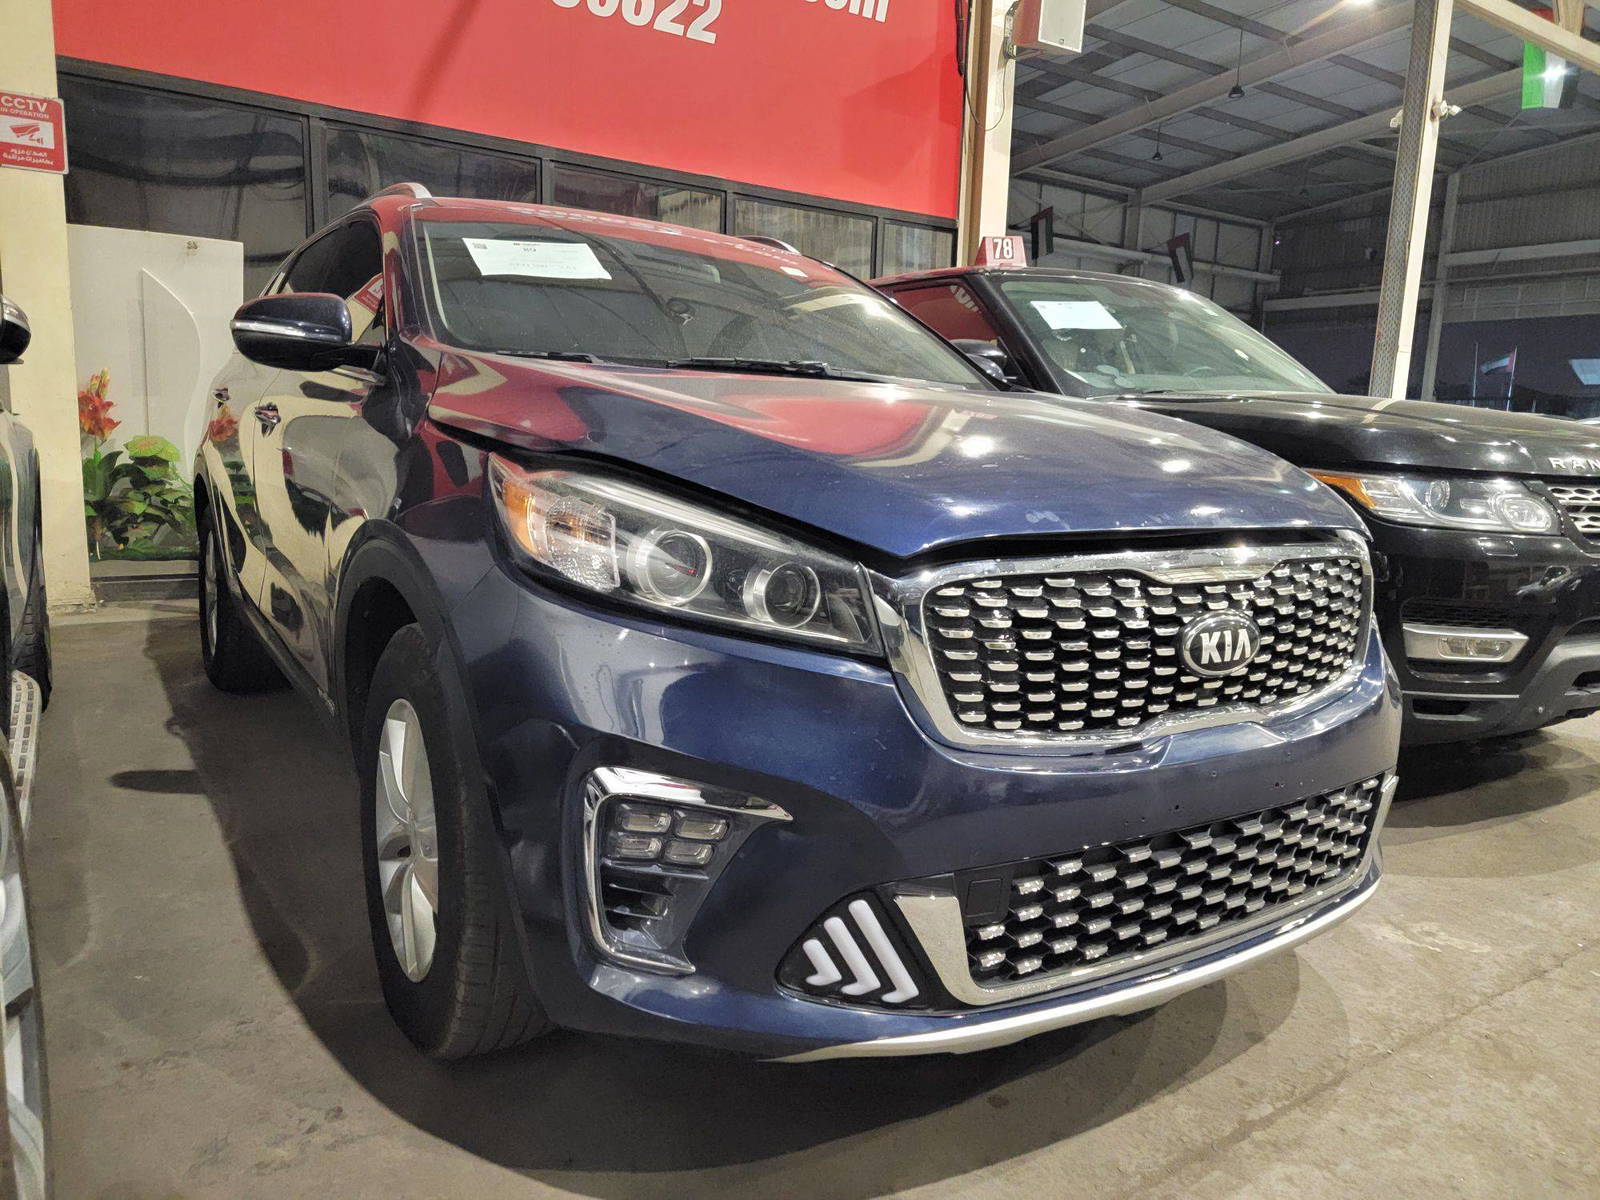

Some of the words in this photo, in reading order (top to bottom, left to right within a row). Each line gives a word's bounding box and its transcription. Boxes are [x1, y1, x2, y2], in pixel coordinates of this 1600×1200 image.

[1, 96, 48, 112] CCTV
[9, 108, 49, 119] OPERATION
[993, 238, 1013, 259] 78
[1200, 629, 1251, 664] KIA
